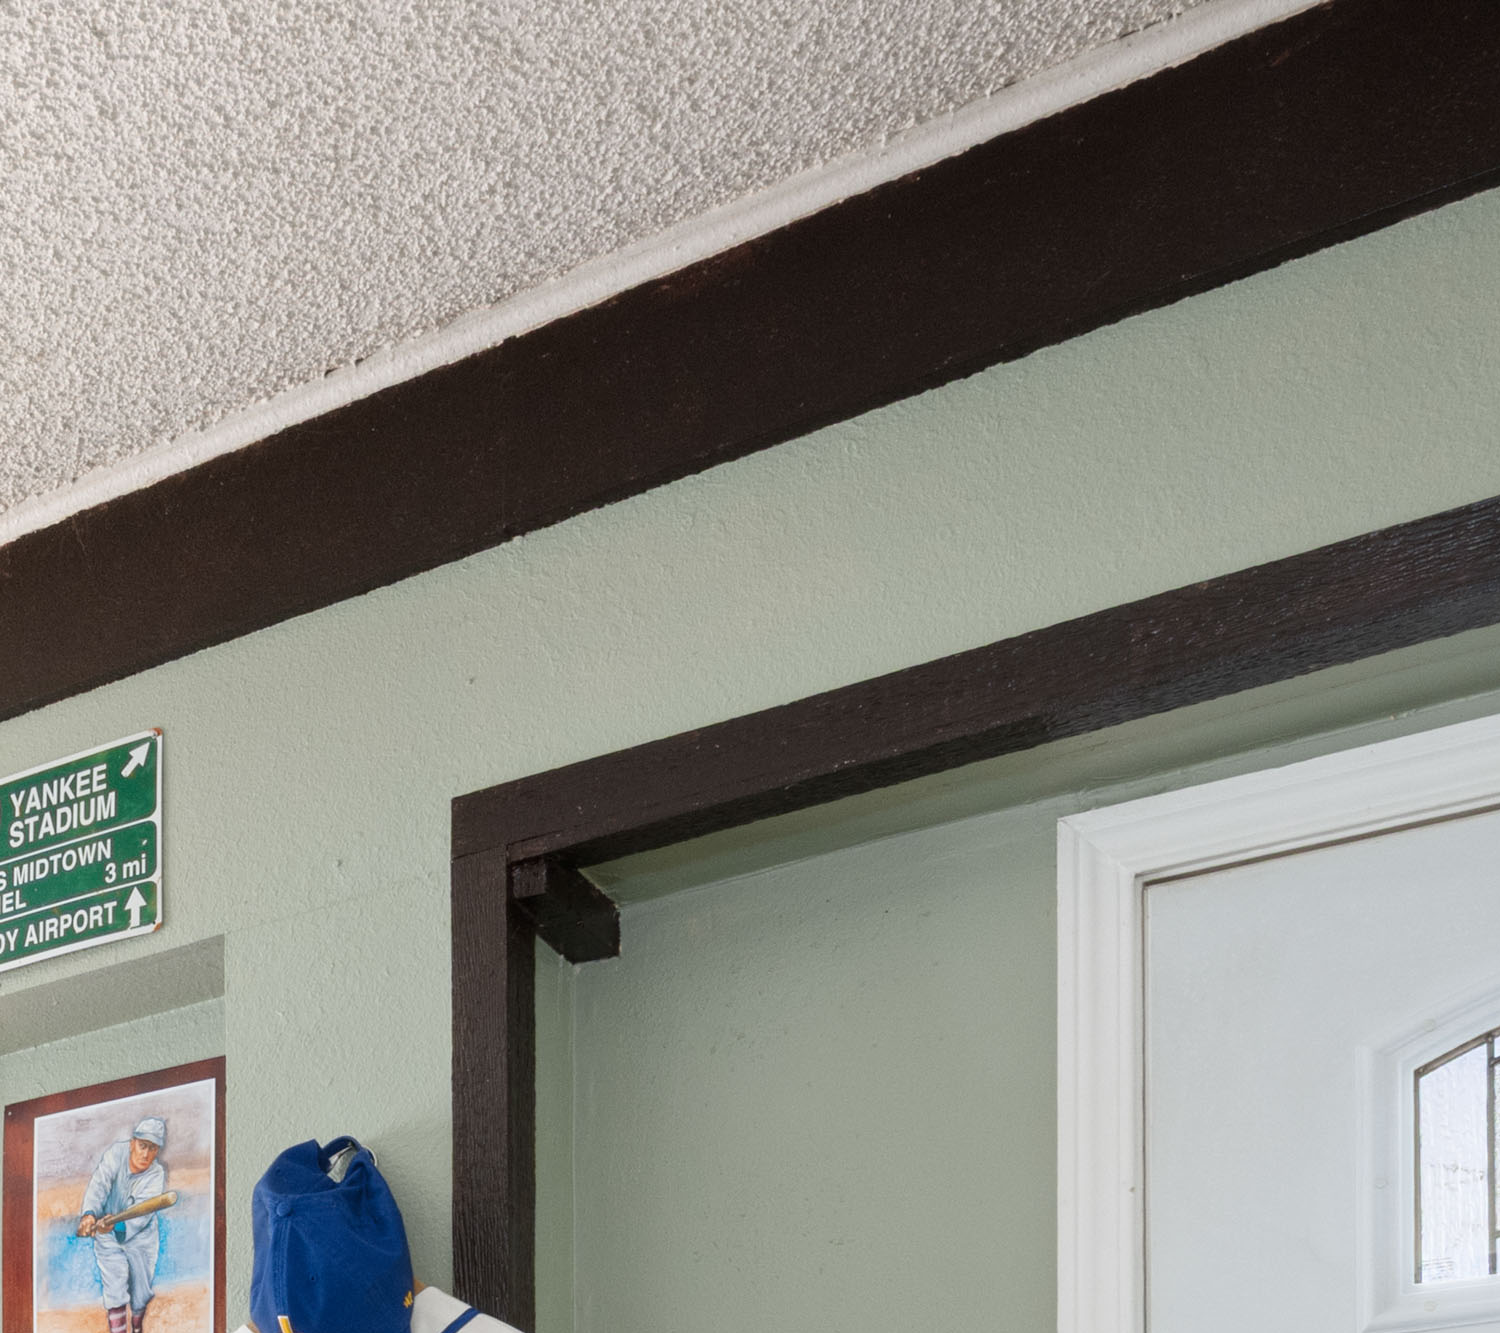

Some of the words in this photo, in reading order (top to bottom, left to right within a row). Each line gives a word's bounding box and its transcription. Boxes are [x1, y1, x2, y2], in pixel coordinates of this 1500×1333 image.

[10, 763, 107, 817] YANKEE
[9, 791, 116, 848] STADIUM
[13, 839, 111, 887] MIDTOWN
[104, 863, 116, 883] 3
[123, 854, 147, 878] mi
[24, 901, 117, 947] AIRPORT
